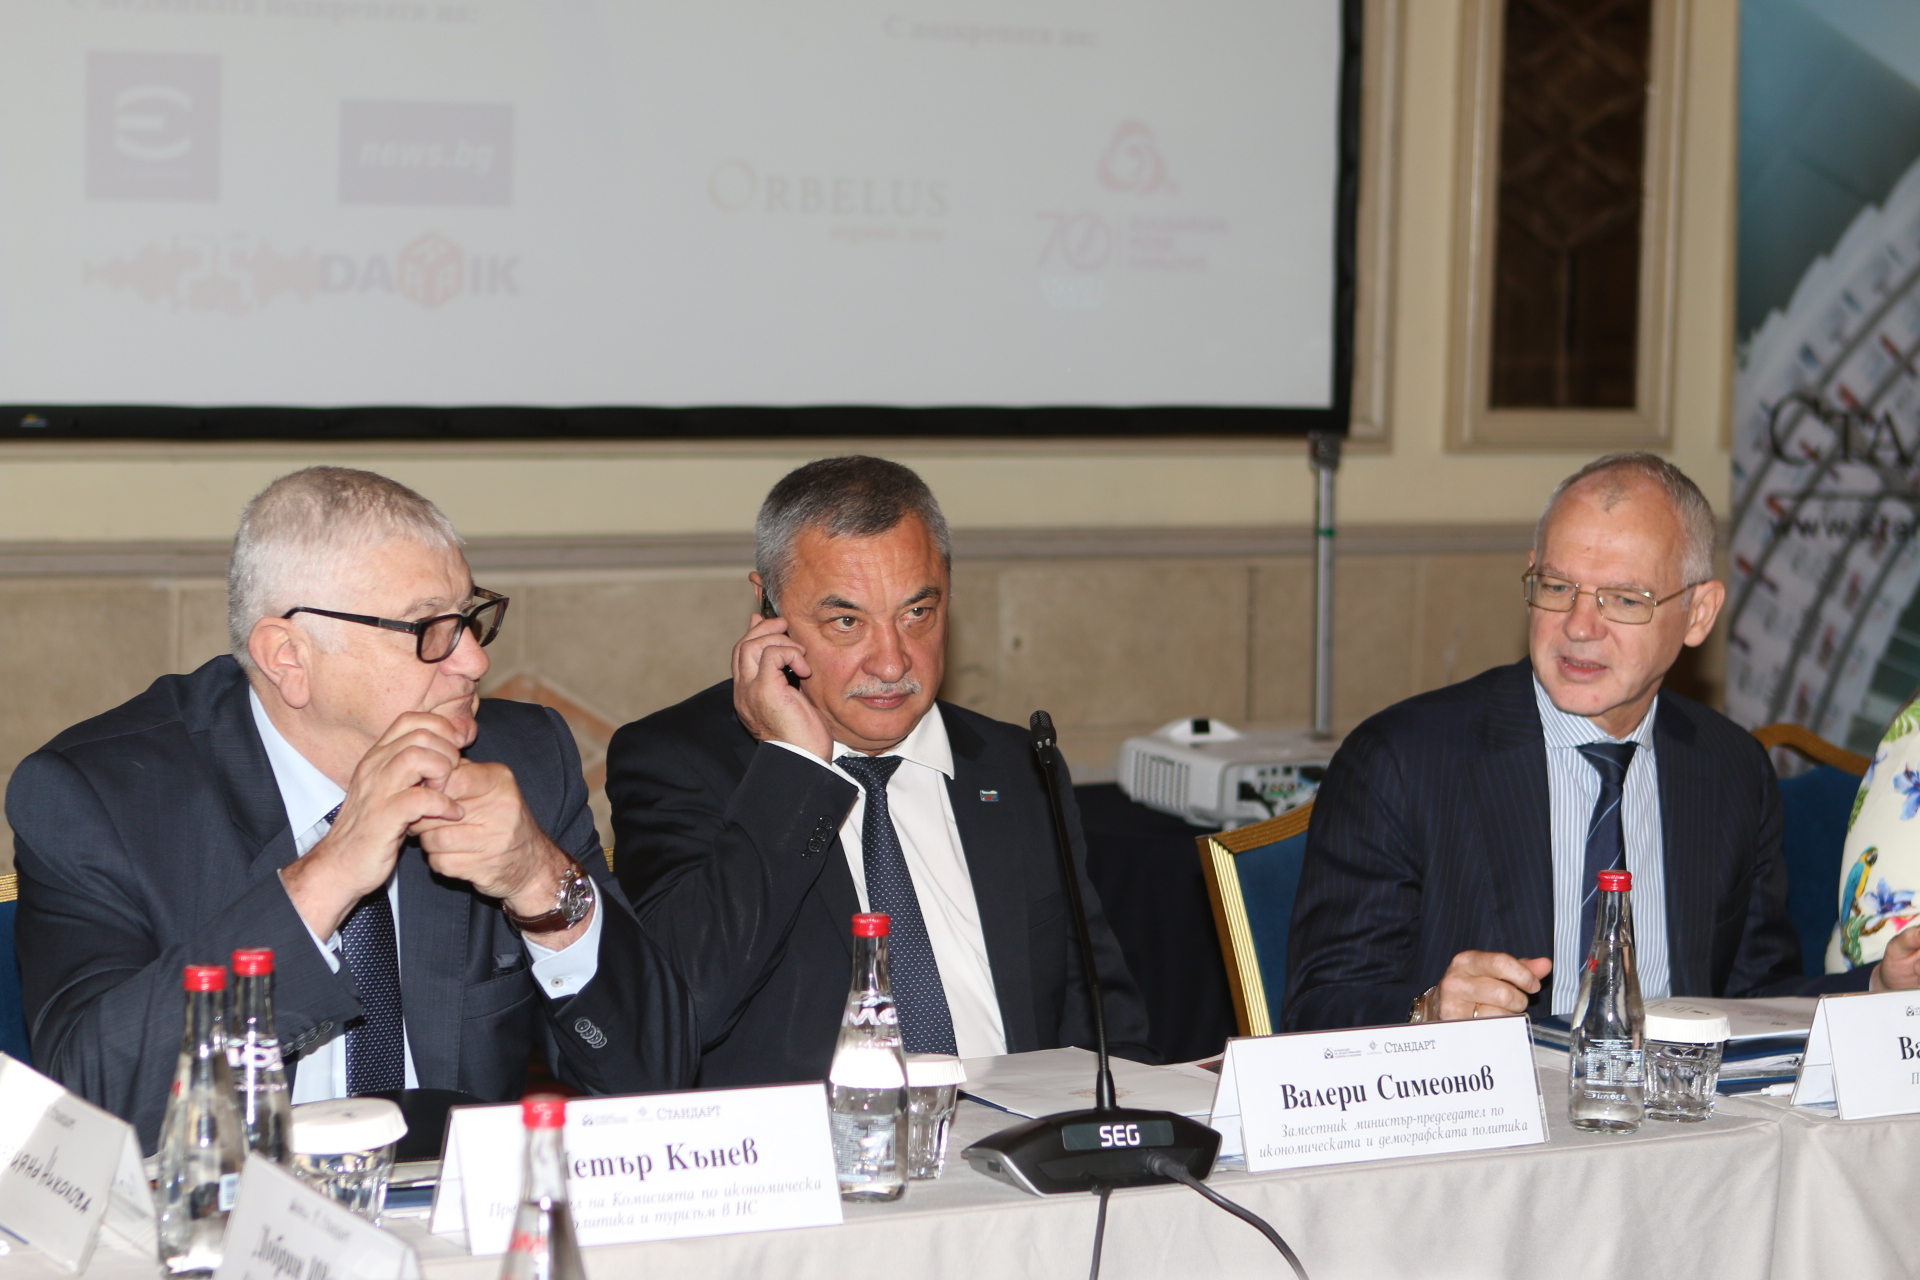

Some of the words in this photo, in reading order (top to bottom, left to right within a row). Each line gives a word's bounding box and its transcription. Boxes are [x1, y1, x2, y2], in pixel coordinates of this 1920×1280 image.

[359, 138, 494, 175] news.bg
[1279, 1083, 1368, 1112] Валери
[1376, 1064, 1495, 1101] Симеонов
[1099, 1123, 1141, 1148] SEG
[1259, 1137, 1361, 1159] икономическата
[1365, 1137, 1374, 1147] и
[1378, 1126, 1468, 1150] демографската
[1471, 1118, 1529, 1137] политика
[1281, 1118, 1348, 1138] Заместник
[1354, 1107, 1487, 1131] министър-председател
[1490, 1106, 1505, 1117] по
[666, 1136, 759, 1172] Кънев
[612, 1188, 695, 1208] Комисията
[701, 1188, 718, 1200] по
[724, 1176, 822, 1197] икономическа
[654, 1207, 716, 1226] туризъм
[736, 1199, 759, 1216] НС
